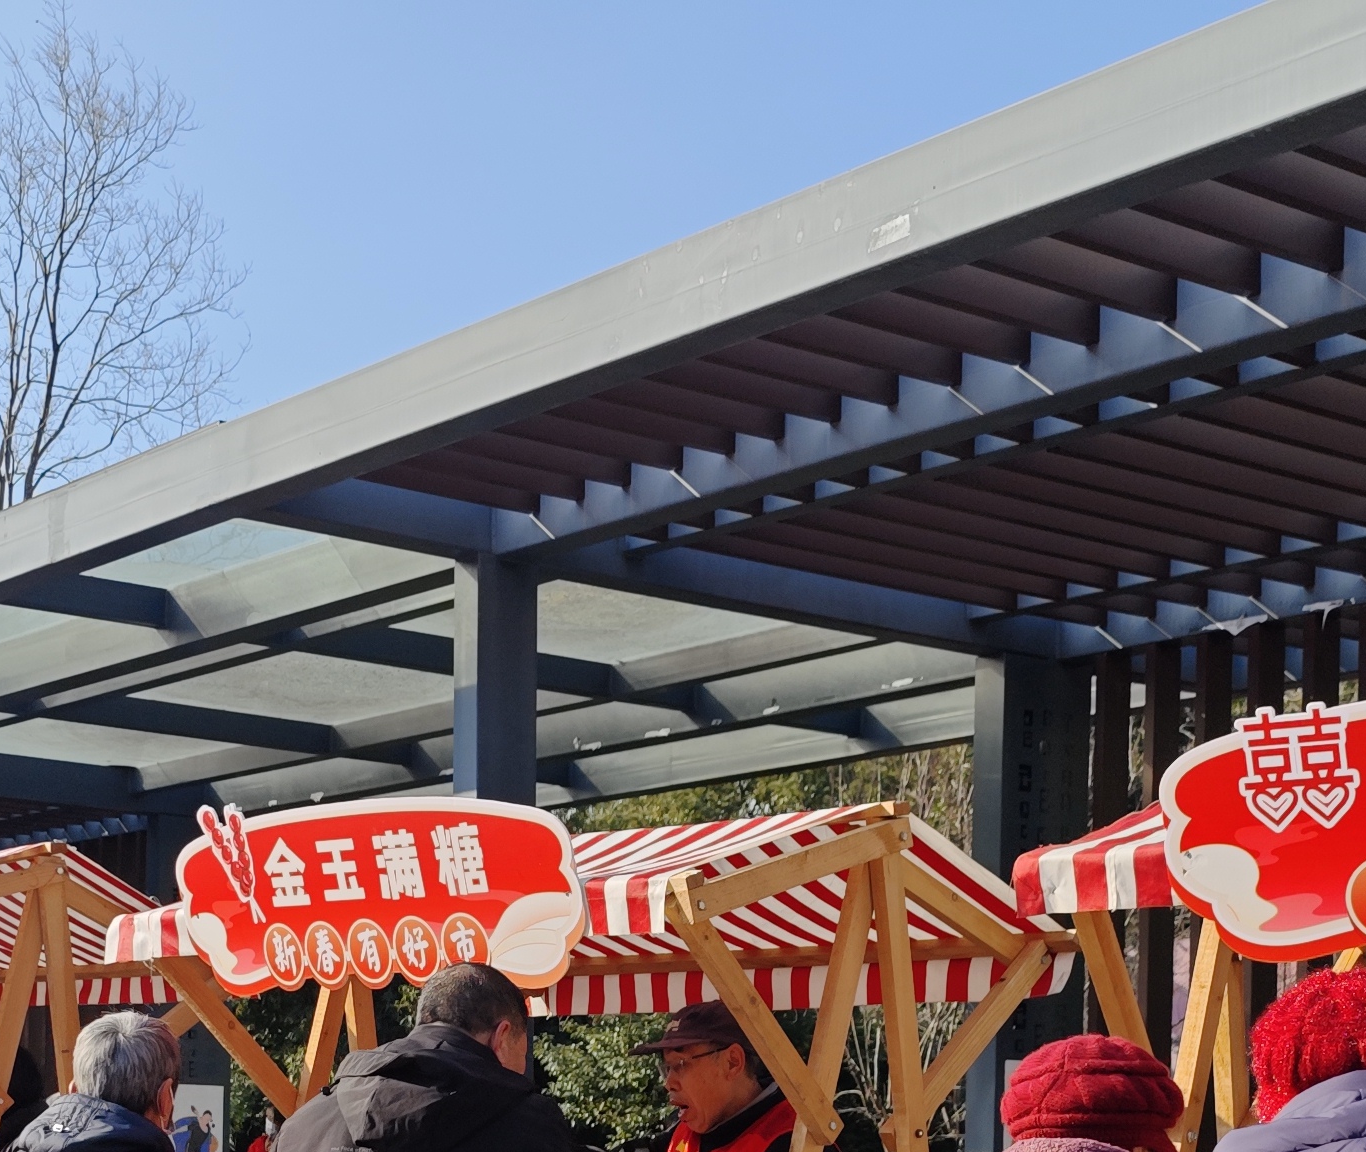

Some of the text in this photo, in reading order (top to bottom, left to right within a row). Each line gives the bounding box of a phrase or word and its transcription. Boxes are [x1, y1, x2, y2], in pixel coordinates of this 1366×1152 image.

[263, 822, 489, 907] 金玉满糖
[272, 921, 476, 976] 新春有好市
